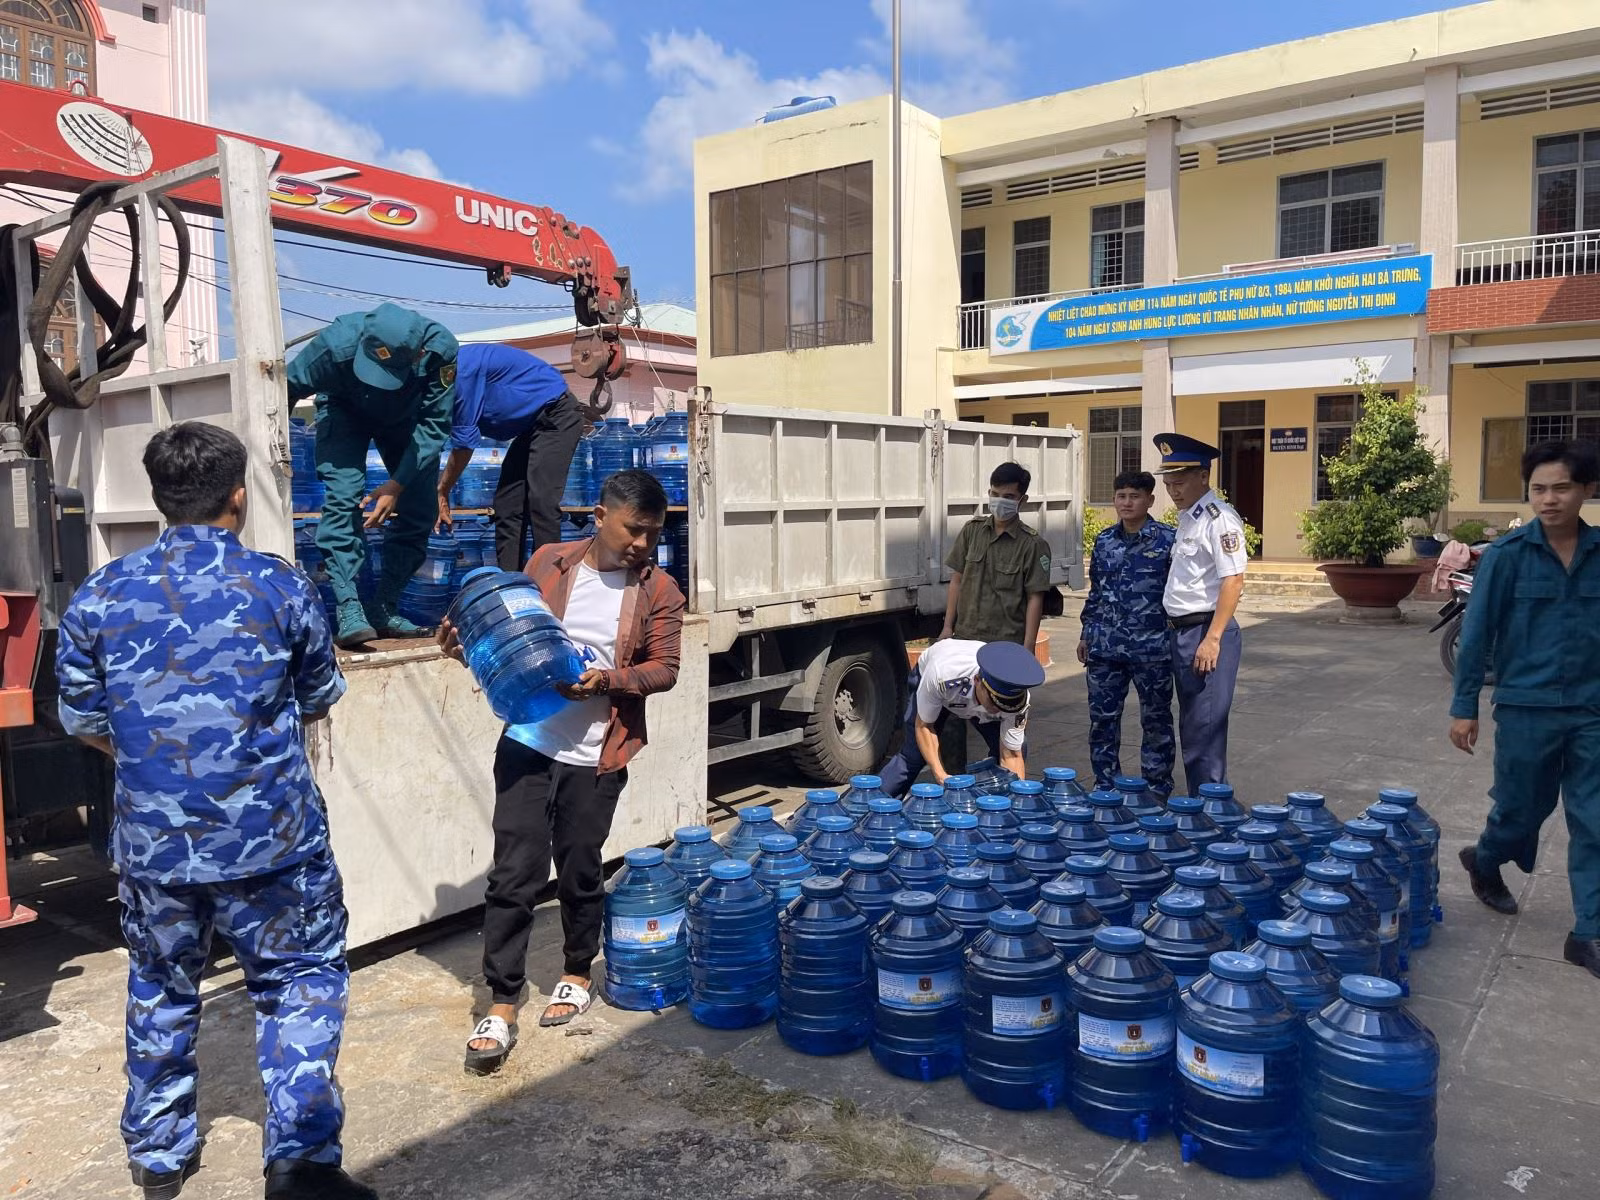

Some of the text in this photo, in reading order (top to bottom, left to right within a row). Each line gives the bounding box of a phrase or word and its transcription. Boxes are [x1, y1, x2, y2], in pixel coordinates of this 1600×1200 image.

[454, 195, 538, 236] UNIC
[1065, 327, 1076, 338] 104
[1111, 321, 1127, 333] SINH
[1128, 319, 1142, 331] ANH
[1213, 309, 1237, 323] TRANG
[1361, 294, 1374, 310] THỊ
[1375, 292, 1396, 309] ĐỊNH
[1080, 304, 1097, 318] CHÀO
[1098, 302, 1117, 316] MỪNG
[1147, 298, 1159, 310] 114
[1160, 294, 1176, 309] NĂM
[1178, 292, 1197, 306] NGÀY
[1258, 285, 1272, 298] 8/3,
[1274, 282, 1292, 296] 1984
[1335, 272, 1360, 289] NGHĨA
[1361, 272, 1376, 286] HAI
